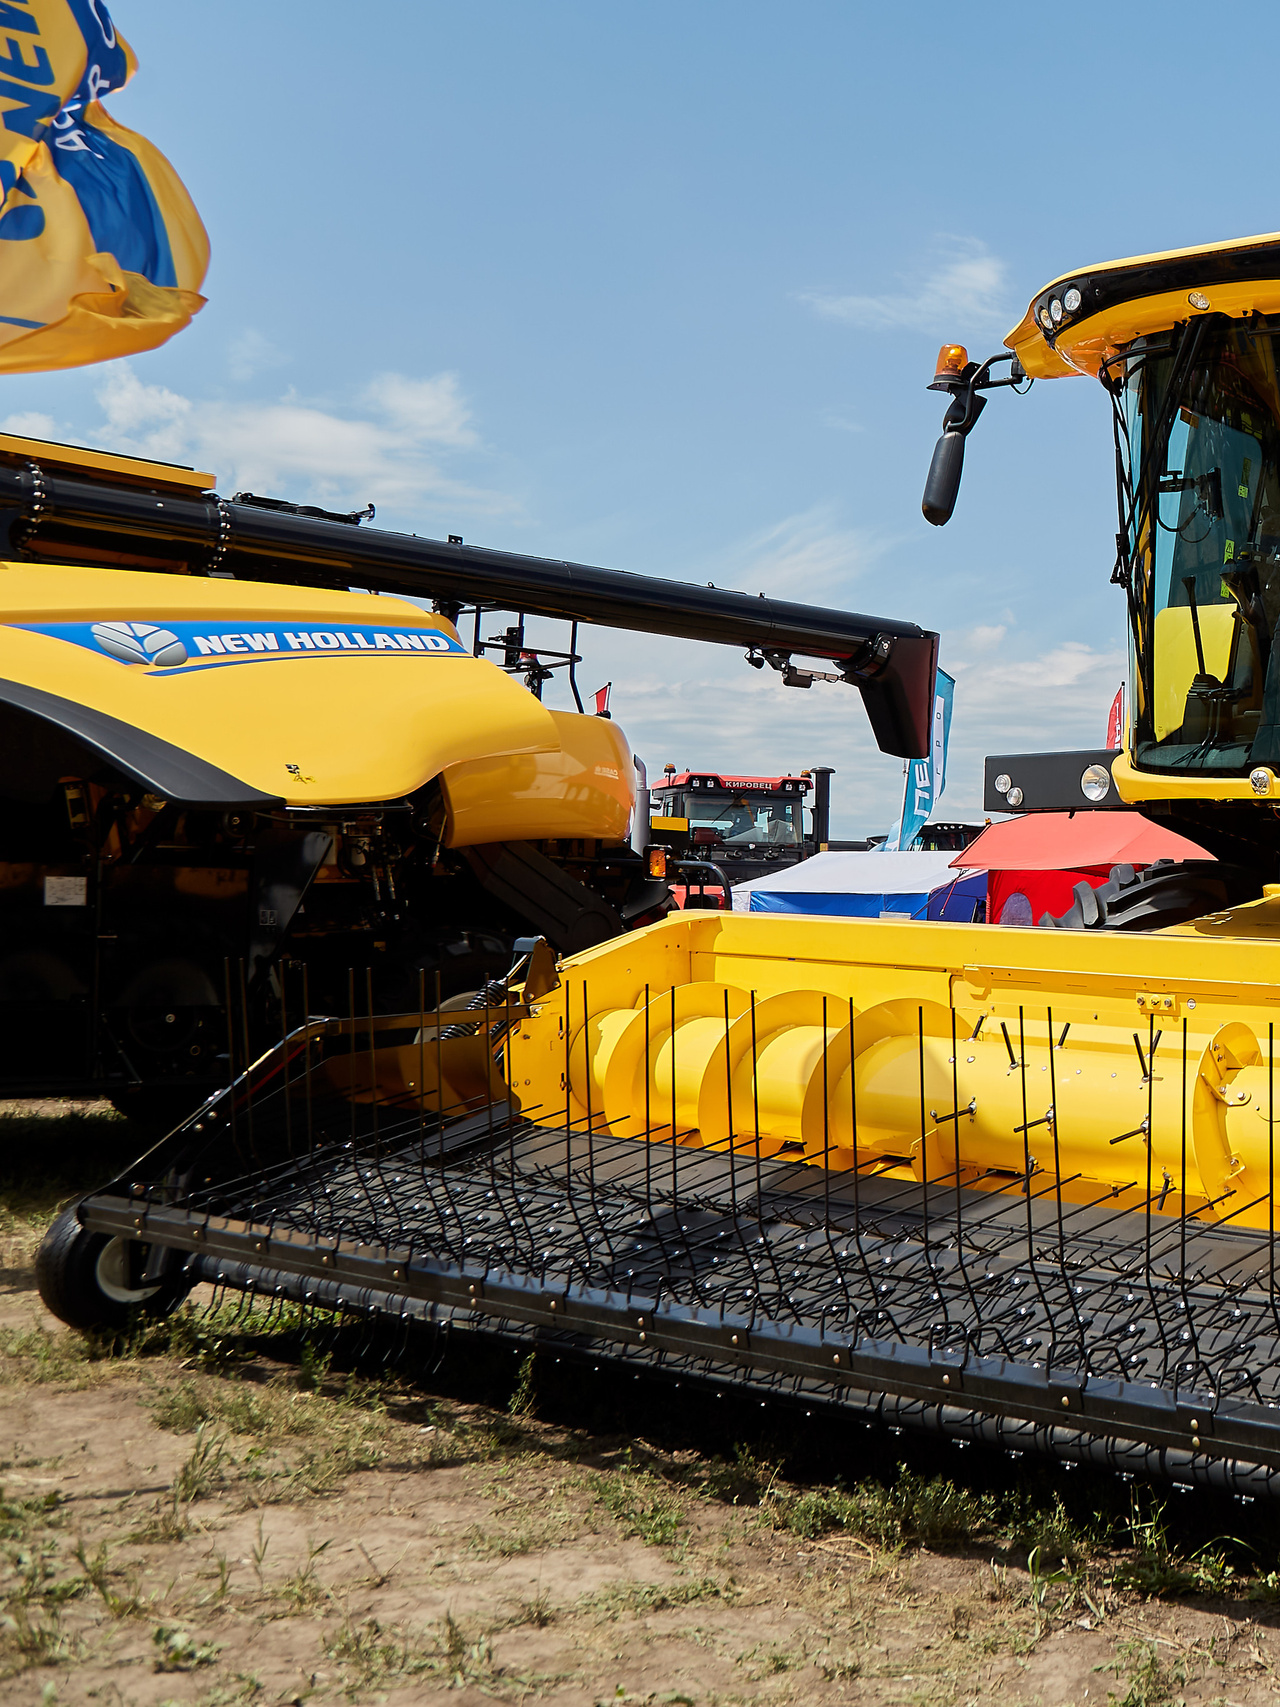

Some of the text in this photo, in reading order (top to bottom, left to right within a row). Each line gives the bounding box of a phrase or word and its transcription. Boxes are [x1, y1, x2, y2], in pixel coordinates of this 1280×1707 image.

[193, 632, 450, 655] NEW HOLLAND
[725, 781, 772, 790] КИРОВЕЦ
